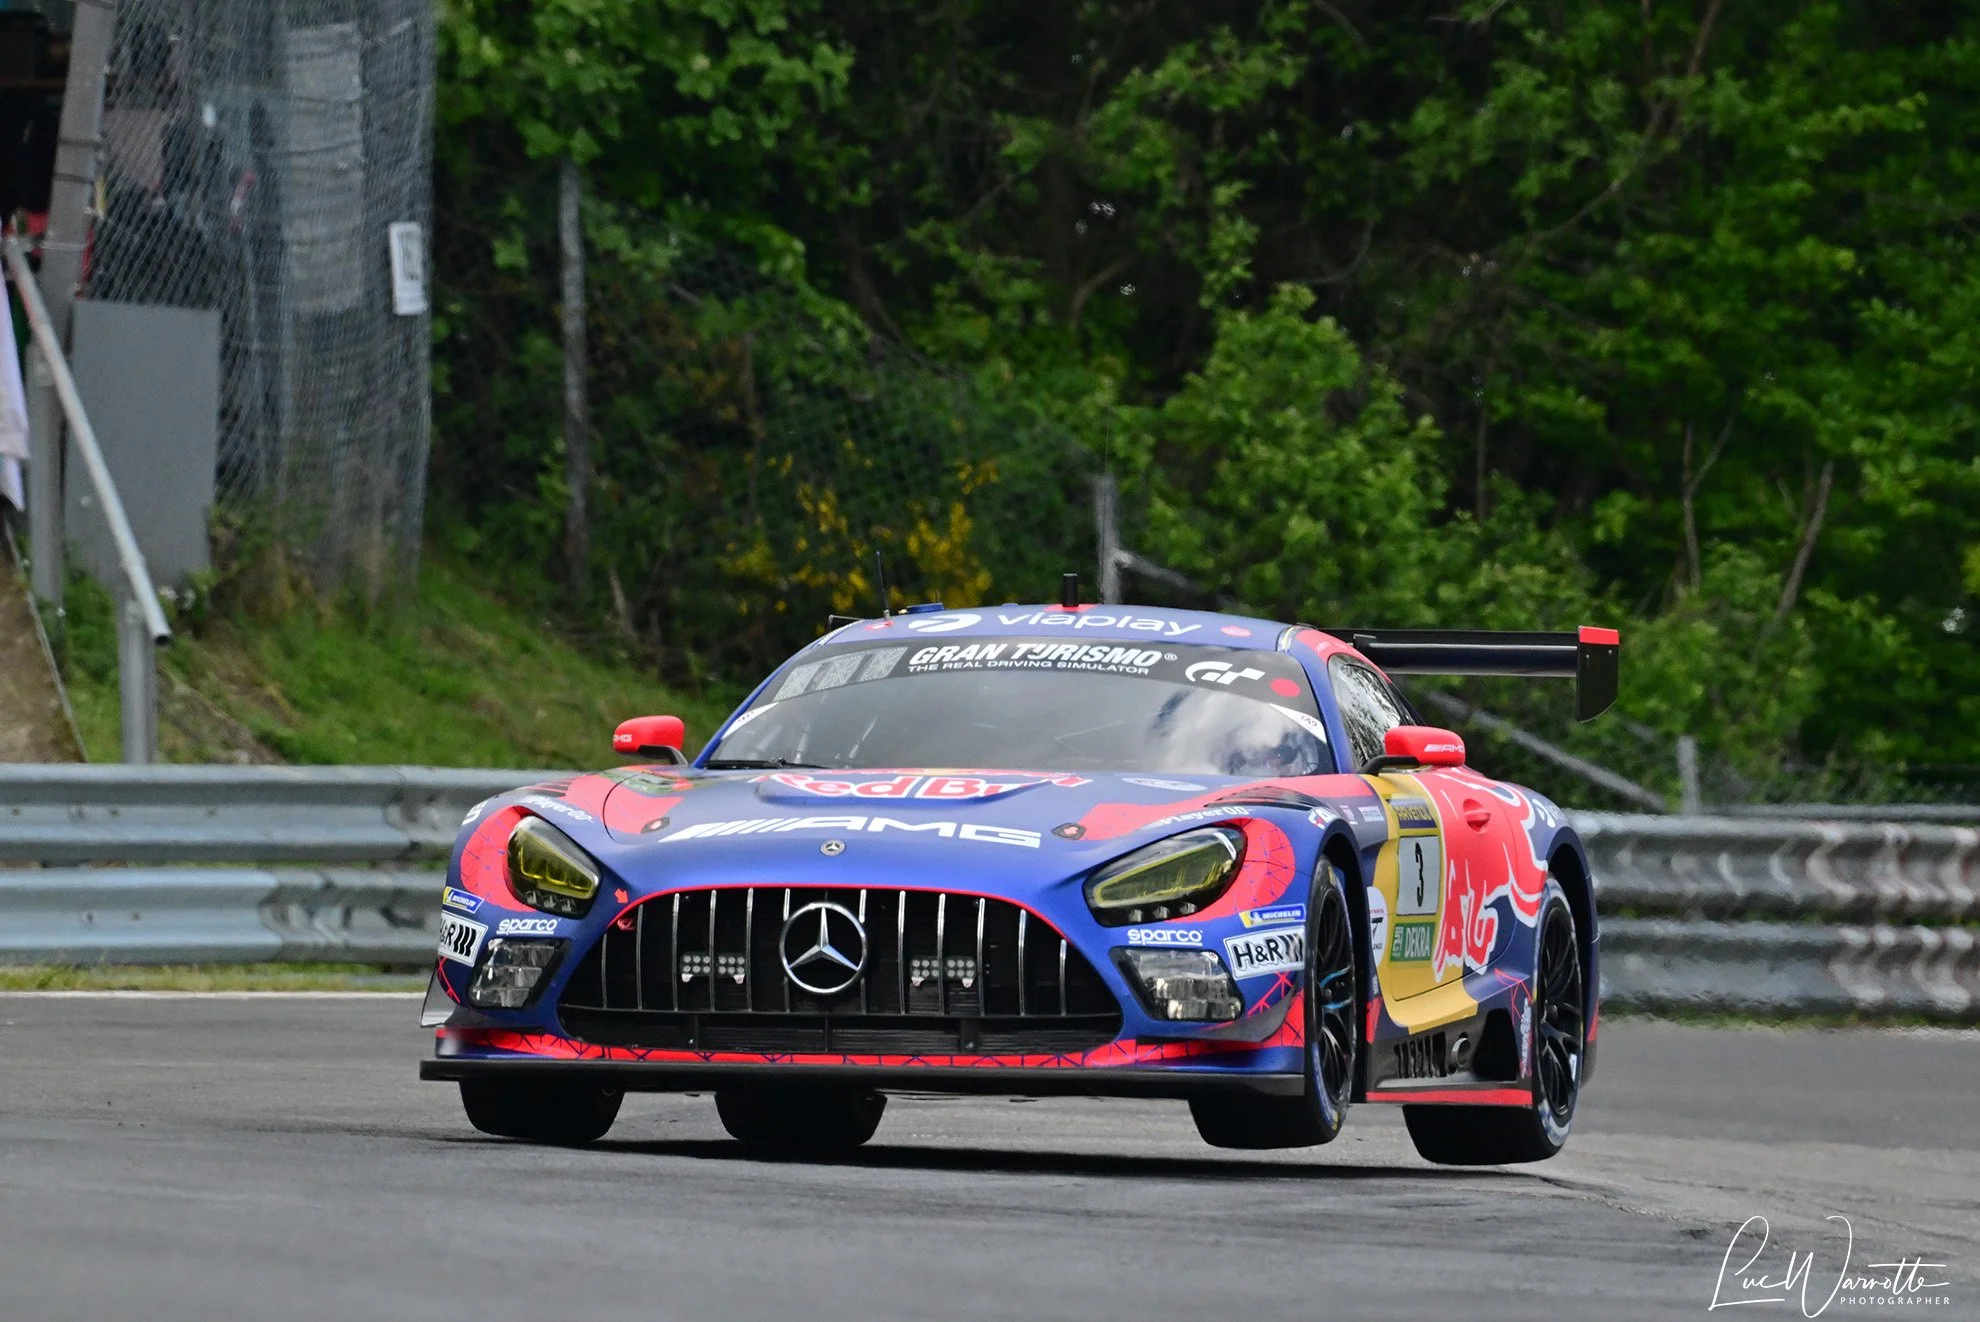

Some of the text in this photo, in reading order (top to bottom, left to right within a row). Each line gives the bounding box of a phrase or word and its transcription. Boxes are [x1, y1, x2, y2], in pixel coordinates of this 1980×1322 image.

[997, 612, 1202, 636] viaplay
[909, 643, 1008, 666] GRAN
[908, 659, 1149, 675] THE REAL DRIVING SIMULATOR
[1413, 842, 1424, 907] 3
[1261, 909, 1302, 920] MICHELIN
[498, 919, 558, 935] sparco
[1127, 929, 1202, 945] sparco
[1233, 938, 1284, 968] H&R
[1404, 925, 1430, 958] DEKRA
